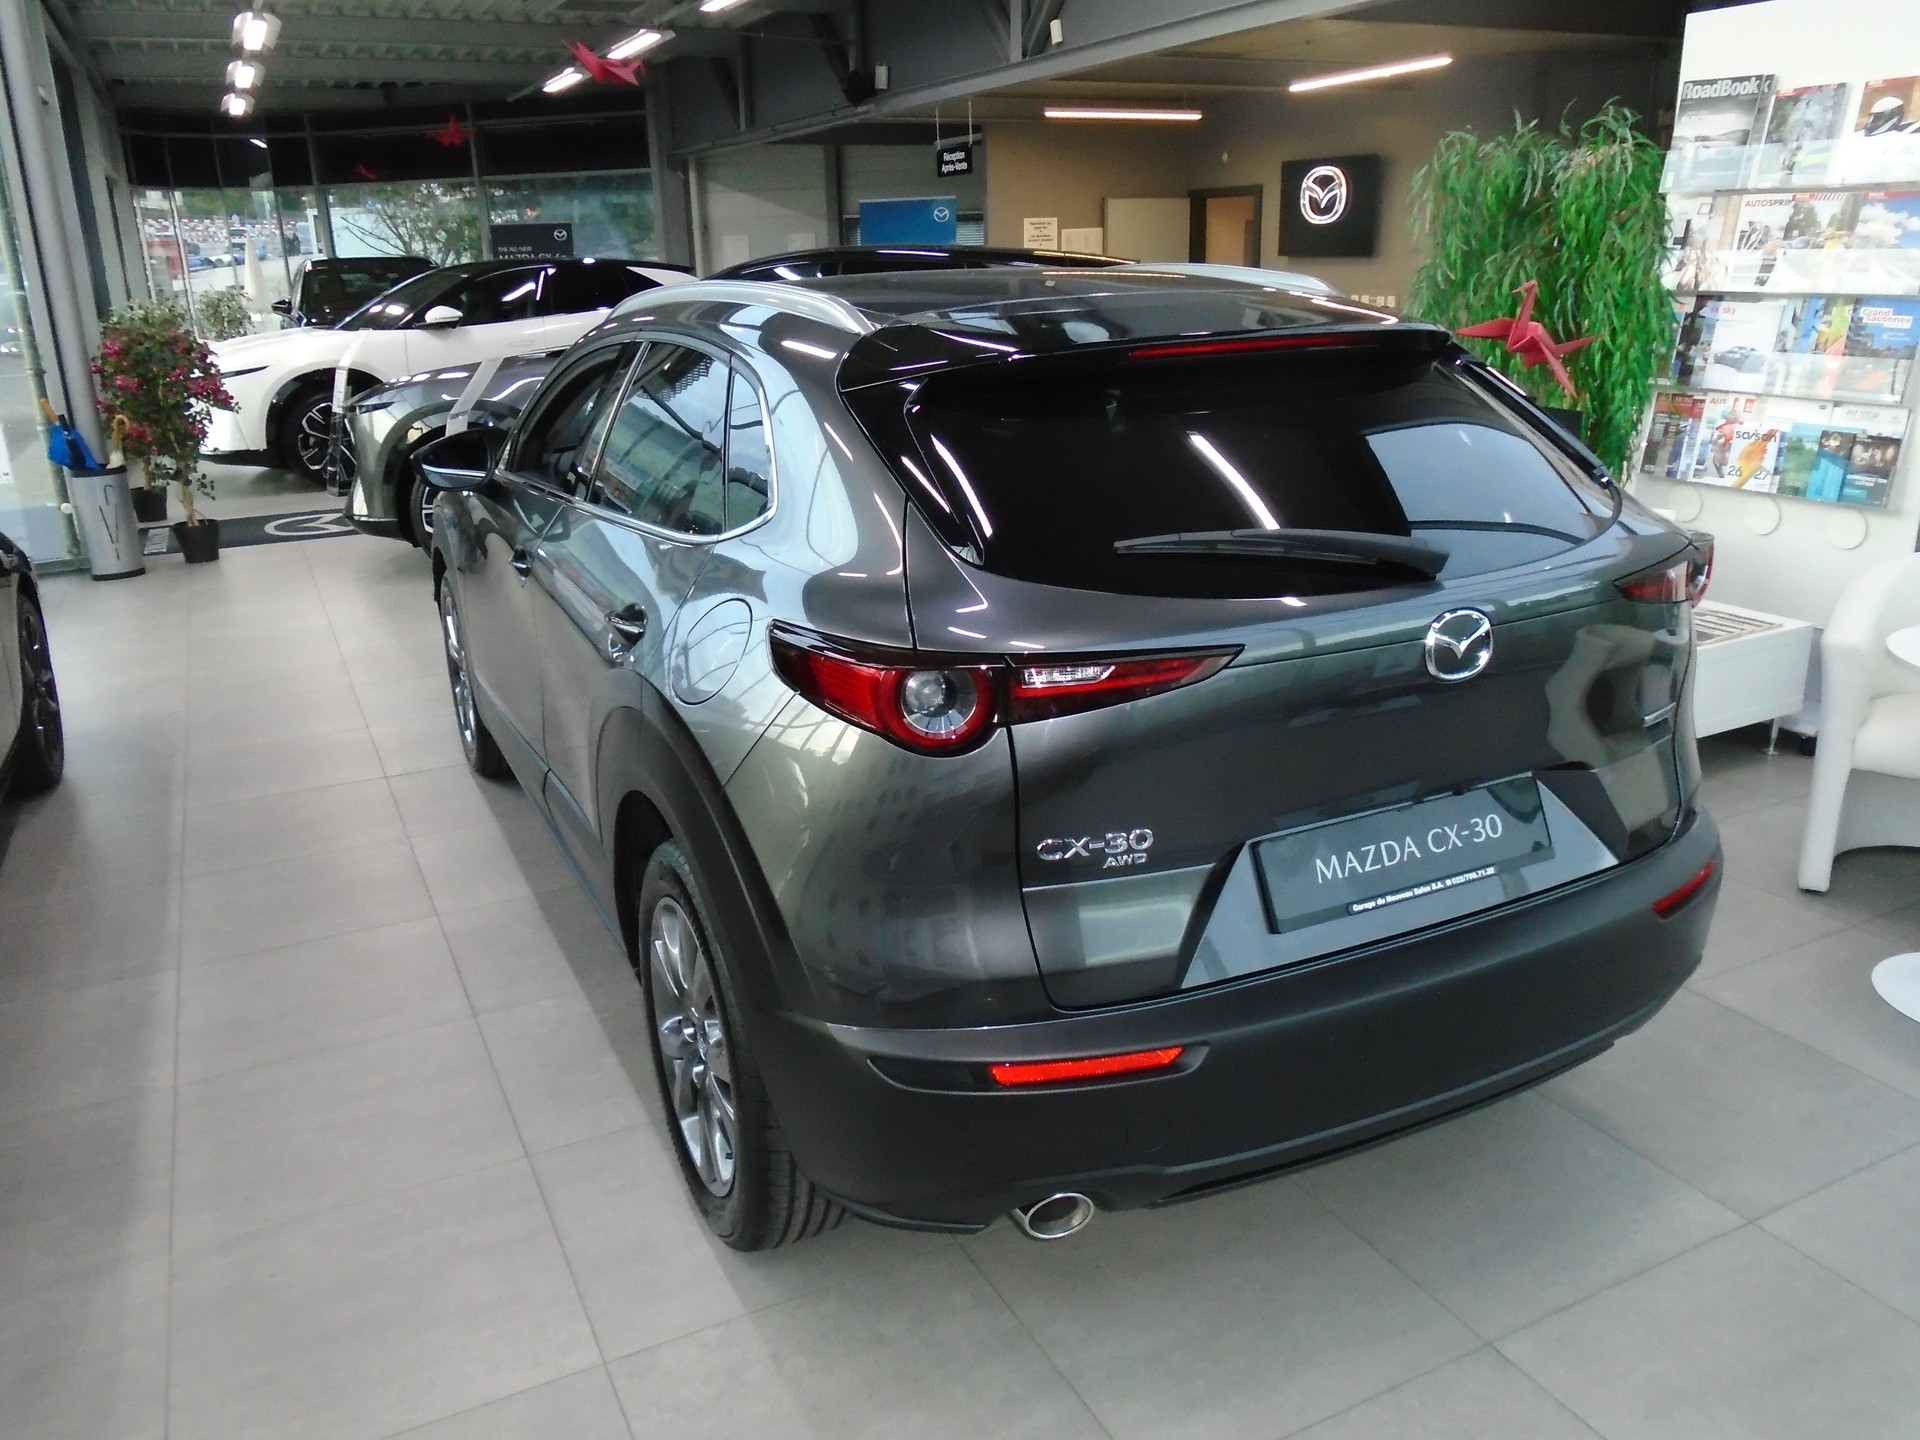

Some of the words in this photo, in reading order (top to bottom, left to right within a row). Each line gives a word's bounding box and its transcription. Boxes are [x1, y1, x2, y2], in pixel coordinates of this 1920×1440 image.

[1682, 77, 1762, 99] RoadBook
[1727, 465, 1744, 478] 26
[1036, 828, 1155, 862] CX-30
[1315, 836, 1421, 885] MAZDA
[1427, 813, 1503, 854] CX-30
[1102, 852, 1148, 869] AWD
[1352, 901, 1376, 912] Garage
[1376, 897, 1386, 907] du
[1386, 890, 1414, 904] Nouveau
[1413, 884, 1432, 897] Salon
